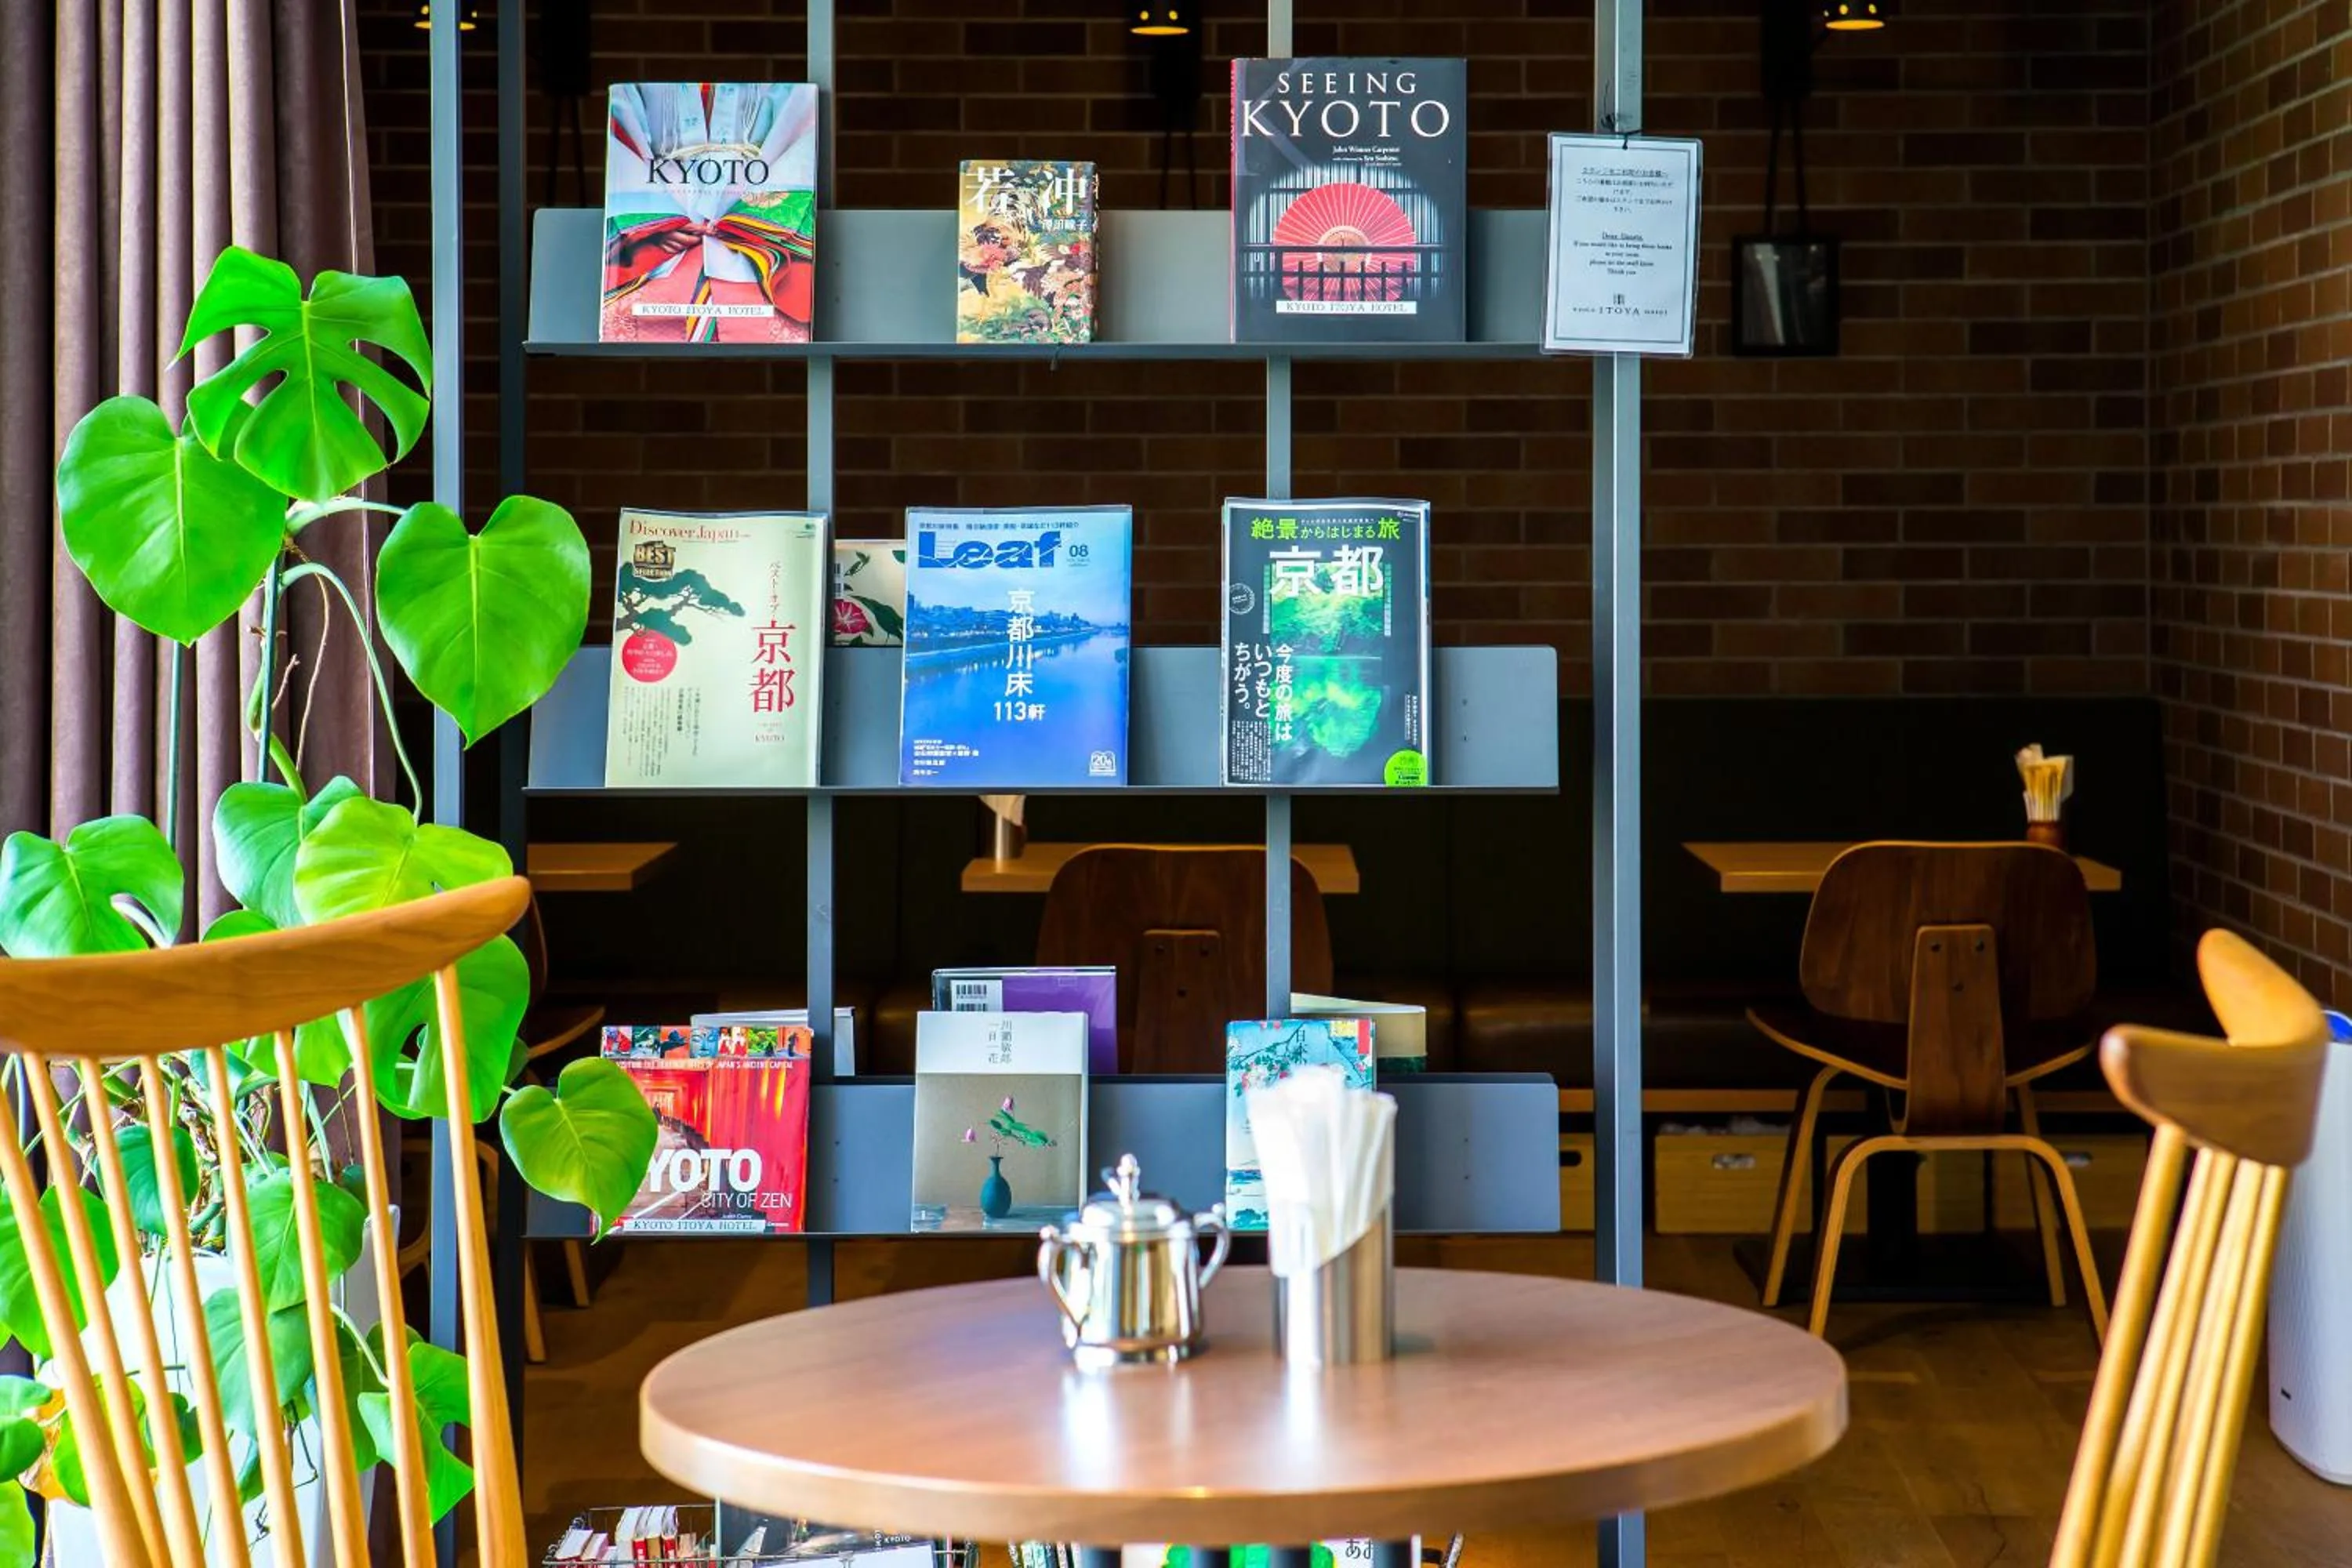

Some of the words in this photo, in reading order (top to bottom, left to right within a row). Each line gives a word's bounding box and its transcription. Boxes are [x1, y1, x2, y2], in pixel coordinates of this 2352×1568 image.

[1278, 72, 1417, 94] SEEING
[1240, 100, 1450, 137] KYOTO
[646, 158, 769, 185] KYOTO
[965, 166, 1088, 215] 若冲
[641, 305, 681, 314] KYOTO
[1286, 302, 1325, 311] KYOTO
[1599, 307, 1640, 315] ITOYA
[630, 519, 695, 538] Discover
[696, 524, 740, 542] Japan
[1250, 517, 1400, 539] 絶景からはじまる旅
[634, 543, 677, 565] BEST
[917, 531, 1062, 568] Leaf
[1068, 544, 1089, 557] 08
[1269, 544, 1384, 597] 京都
[1005, 587, 1035, 697] 京都川床
[748, 619, 797, 713] 京都
[1234, 641, 1252, 710] ちがう。
[1254, 643, 1272, 719] いつもと
[1275, 643, 1294, 742] 今度の旅は
[994, 701, 1046, 722] 113軒
[640, 1149, 763, 1192] YOTO
[701, 1192, 732, 1209] CITY
[736, 1192, 757, 1208] OF
[760, 1192, 792, 1208] ZEN
[633, 1220, 673, 1229] KYOTO
[719, 1220, 753, 1229] HOTEL
